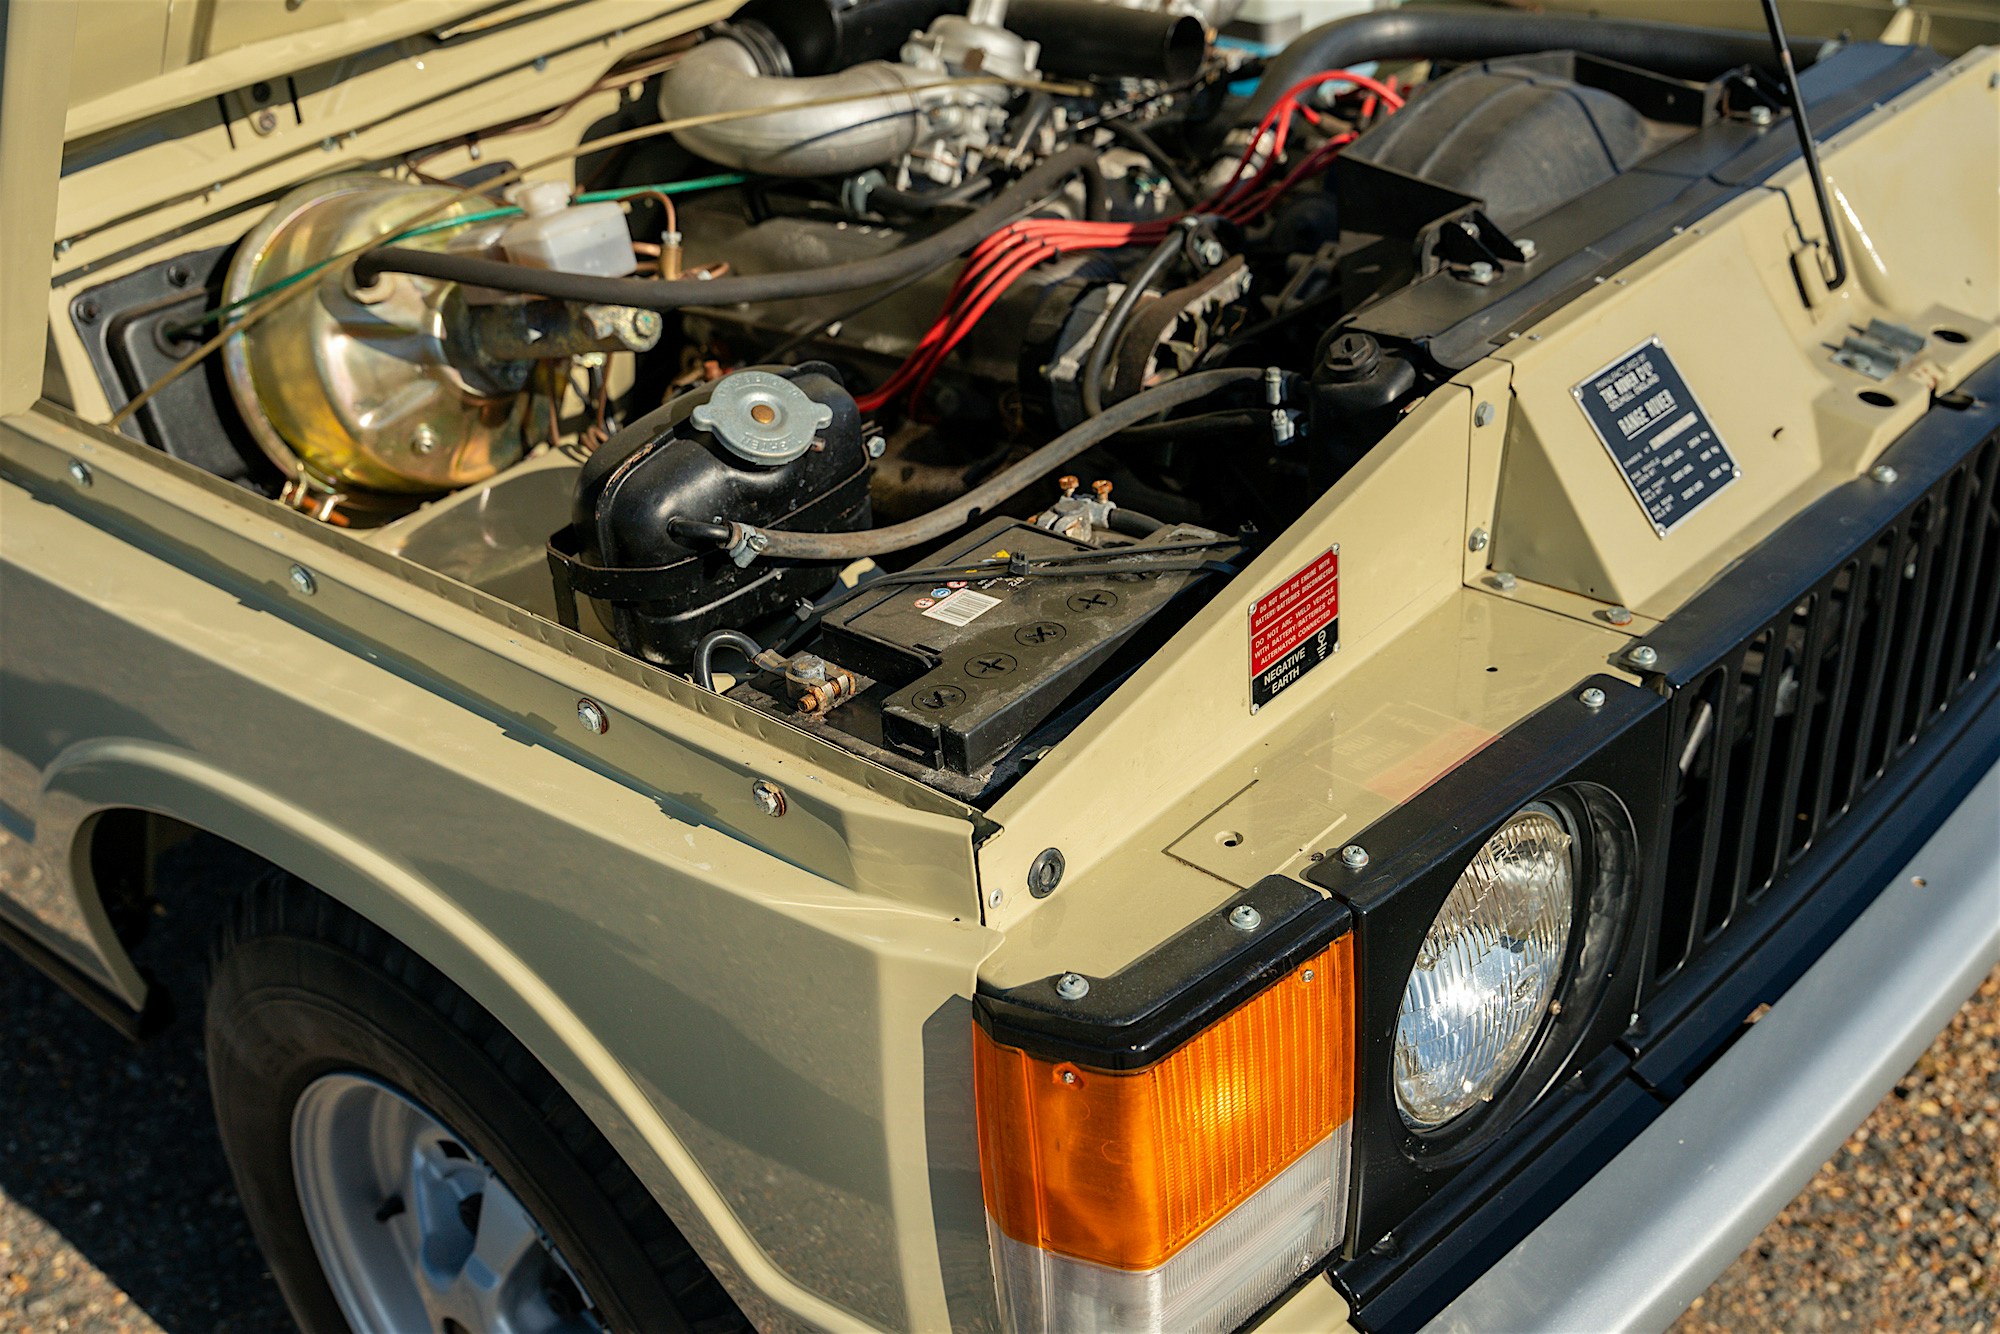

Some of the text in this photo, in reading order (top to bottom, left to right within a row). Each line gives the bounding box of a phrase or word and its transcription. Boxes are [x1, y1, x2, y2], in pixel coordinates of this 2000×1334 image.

[1617, 388, 1675, 436] RANGE ROVER
[1259, 558, 1330, 614] DO NOT RUN THE ENGINE WITH
[1302, 565, 1334, 594] DISCONNECTED
[1254, 595, 1335, 659] WITH BATTERY/BATTERIES OR
[1255, 586, 1334, 649] DO NOT ARC WELD VEHICLE
[1261, 610, 1330, 666] ALTERNATOR CONNECTED
[1264, 647, 1306, 686] NEGATIVE
[1272, 666, 1300, 694] EARTH
